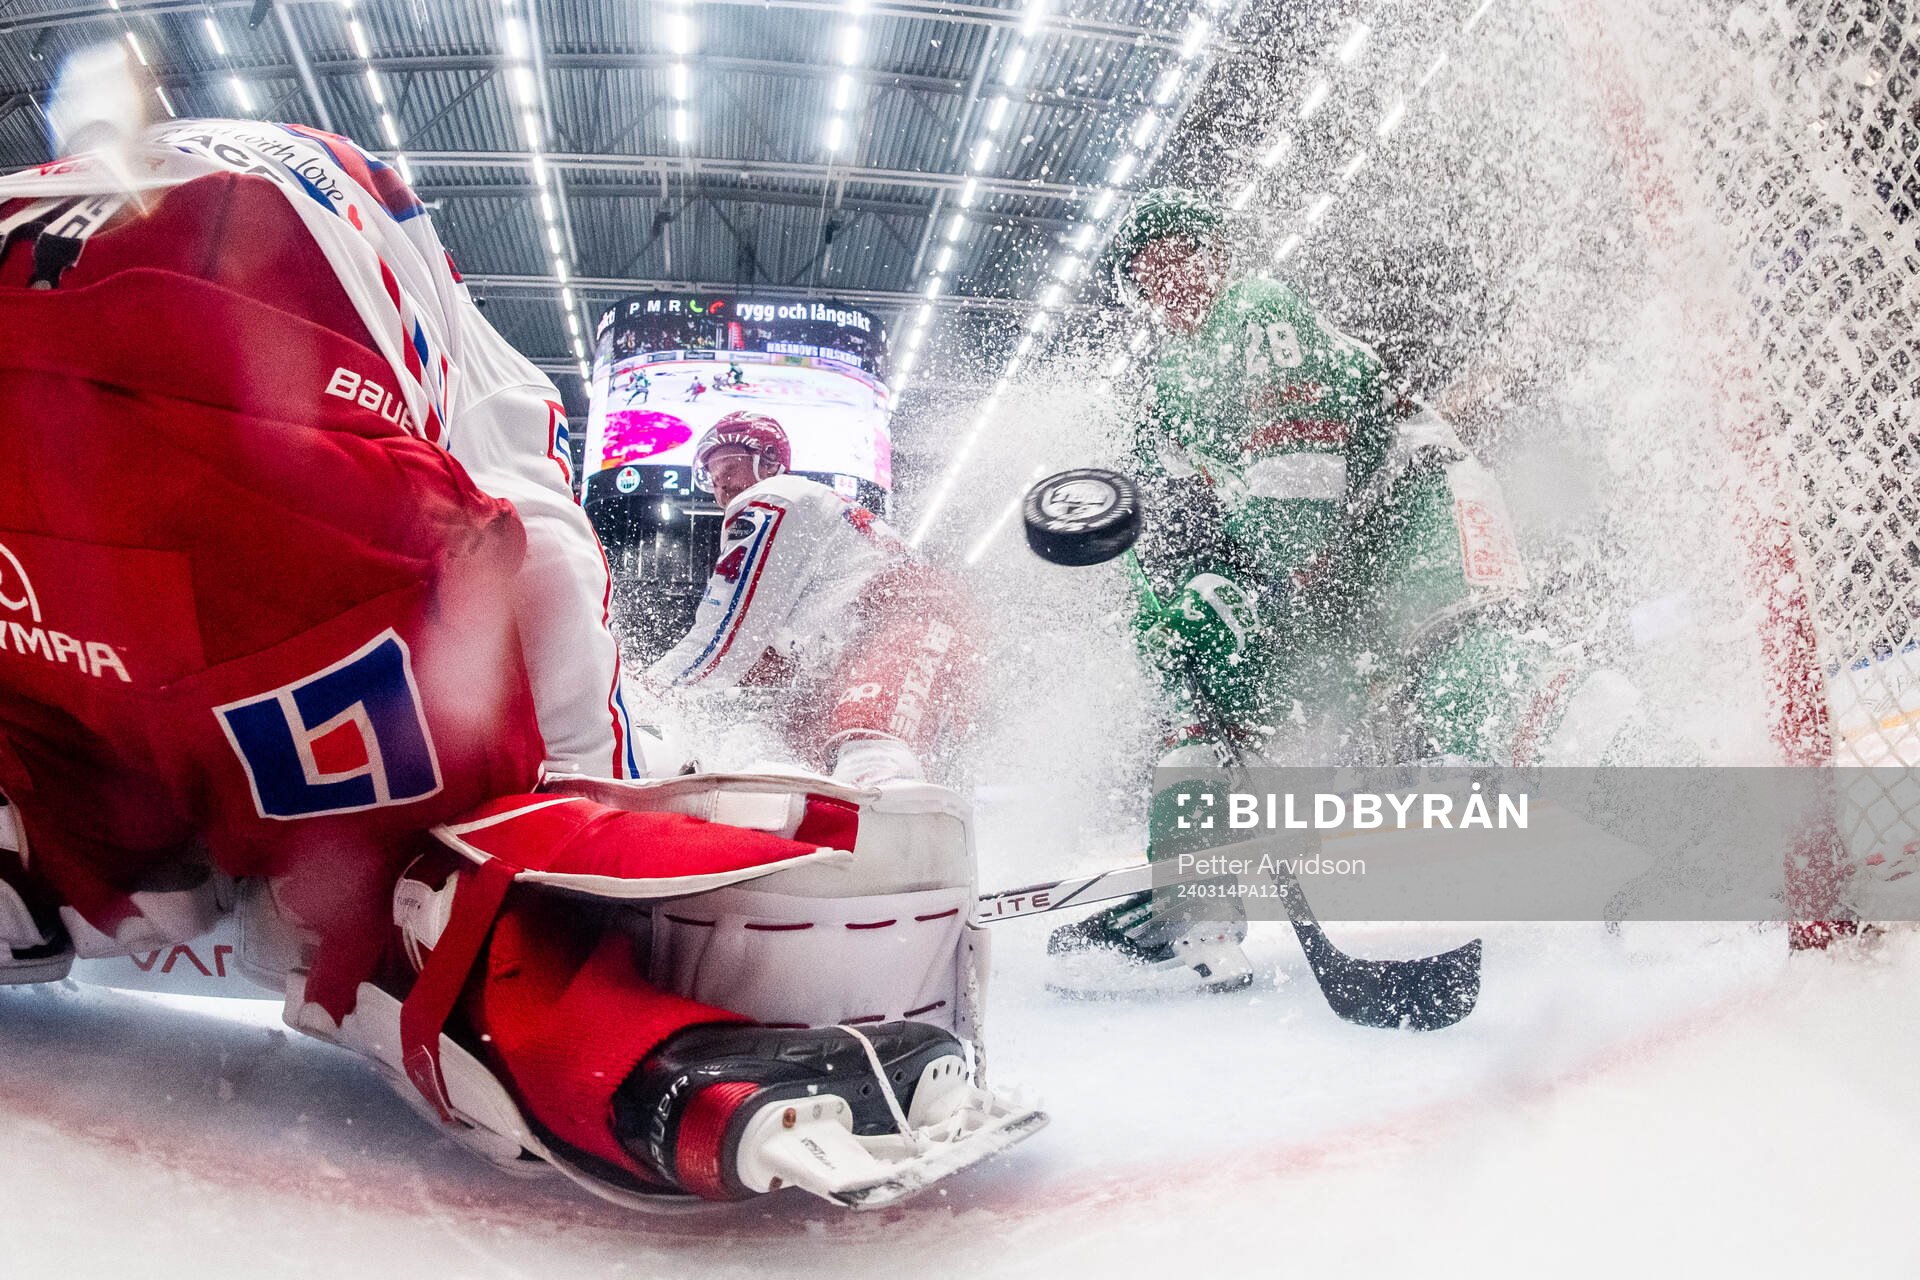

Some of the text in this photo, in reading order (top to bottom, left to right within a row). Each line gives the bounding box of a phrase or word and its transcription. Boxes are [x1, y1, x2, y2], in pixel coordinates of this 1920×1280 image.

[233, 131, 344, 201] with love
[629, 299, 681, 315] P M R
[736, 303, 871, 333] rygg och långsikt
